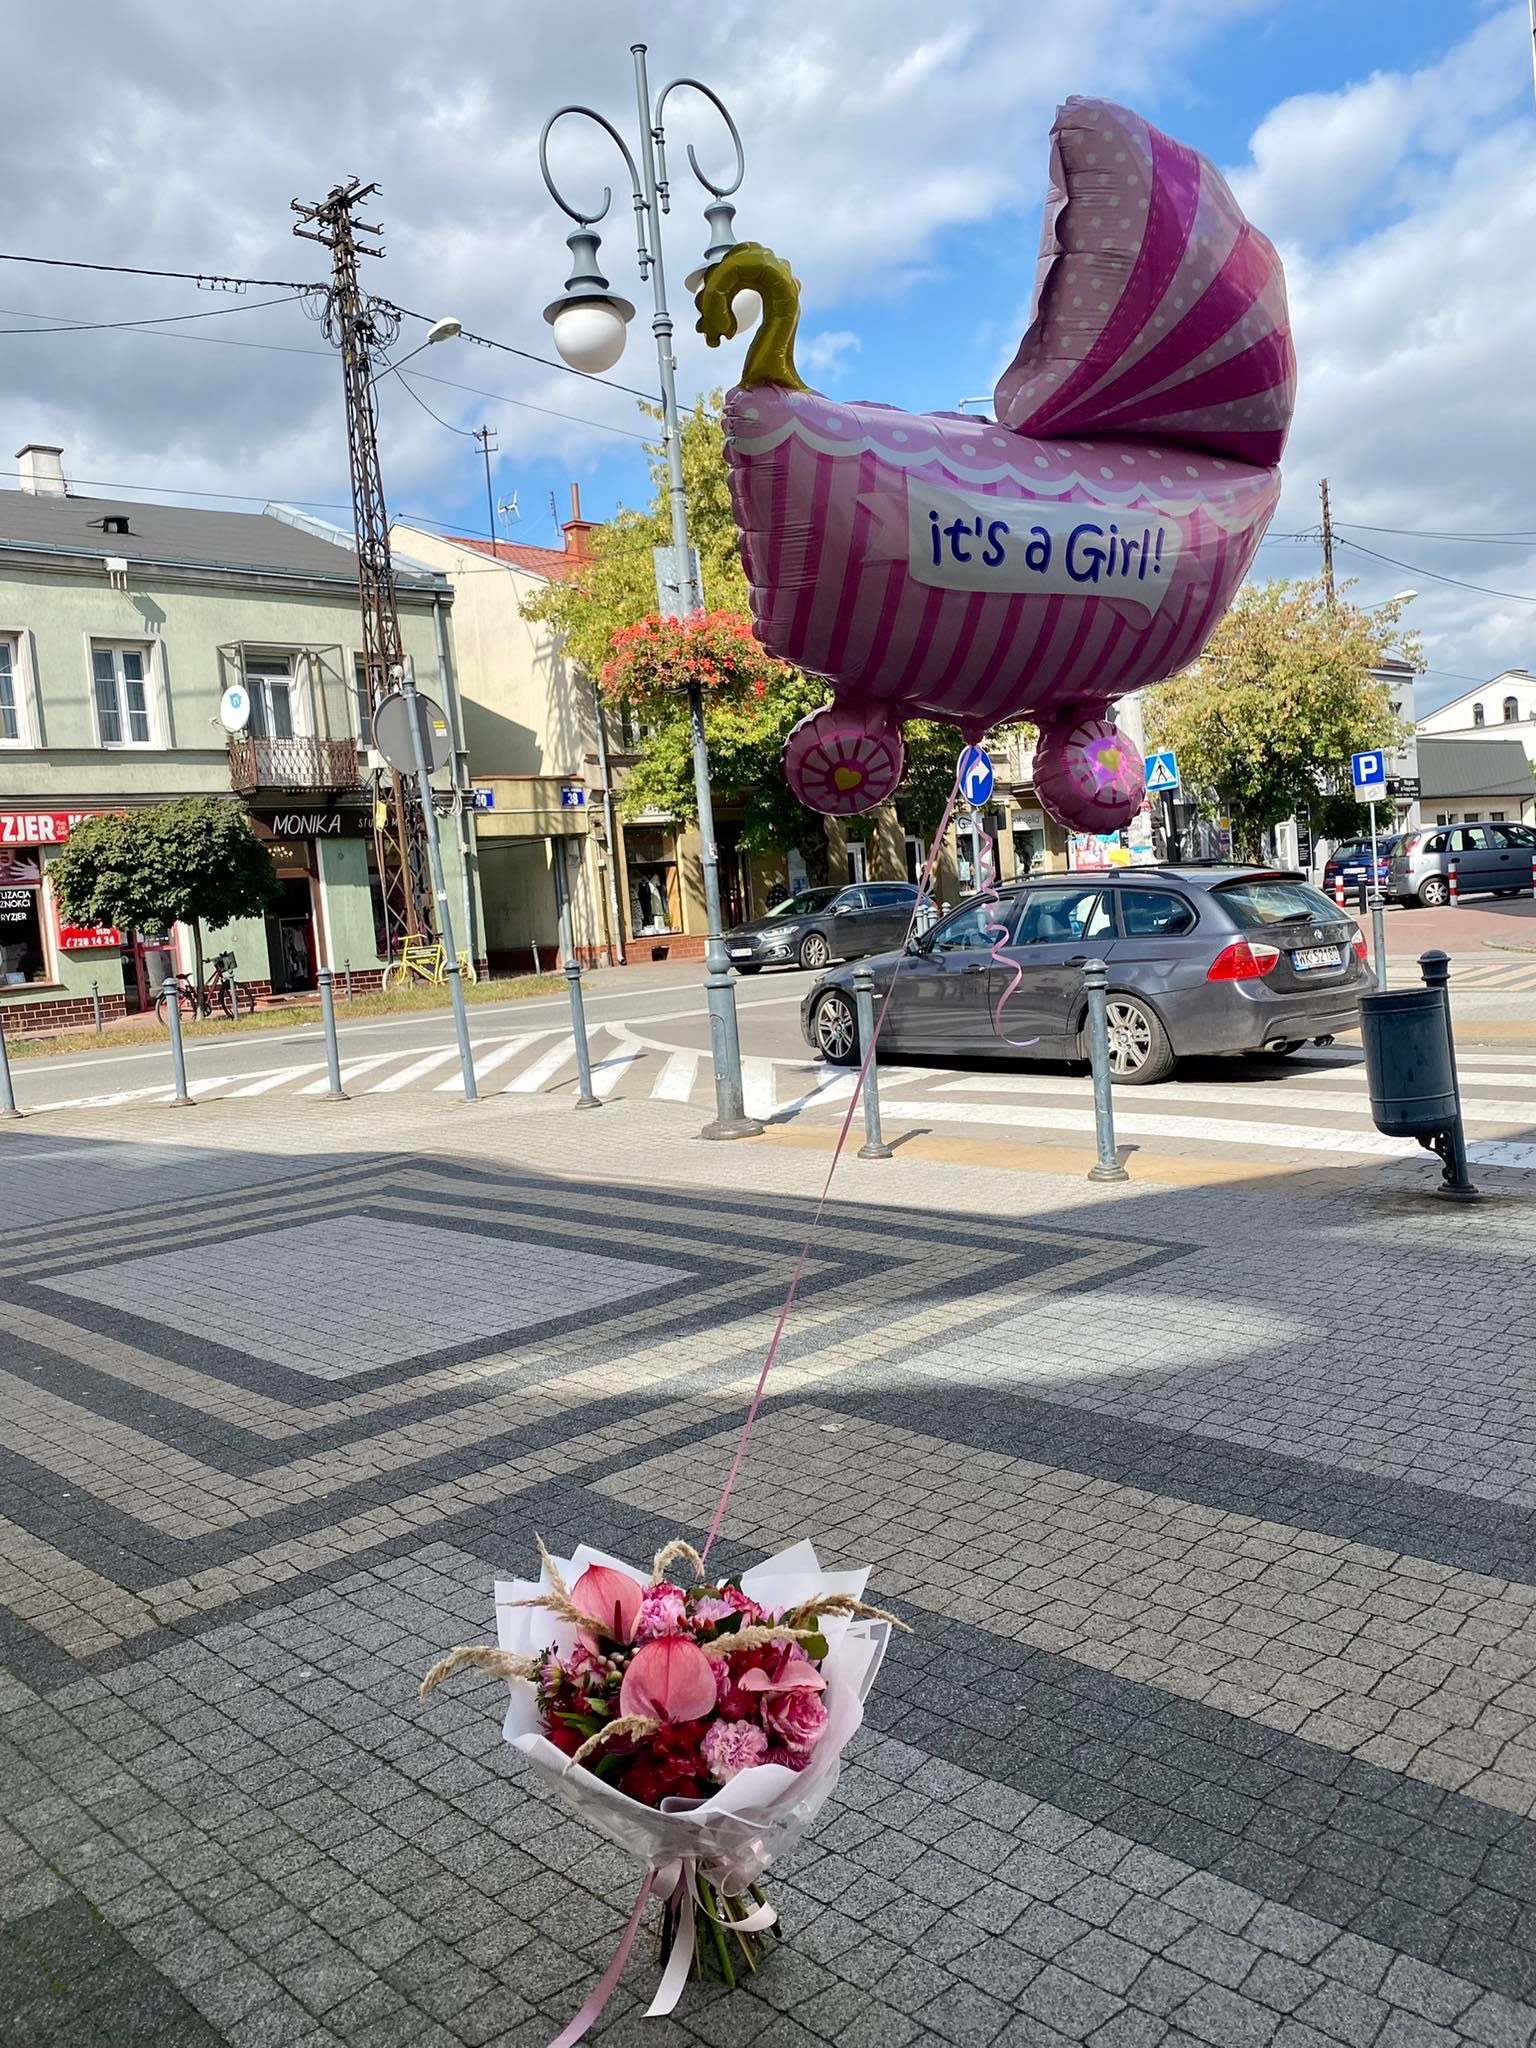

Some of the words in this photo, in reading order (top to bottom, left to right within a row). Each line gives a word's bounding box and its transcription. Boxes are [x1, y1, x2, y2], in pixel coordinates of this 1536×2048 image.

[928, 510, 1010, 567] it's
[1025, 526, 1053, 574] a
[1065, 523, 1165, 583] Girl!
[1359, 755, 1378, 783] P
[0, 815, 56, 841] ZJER
[273, 814, 342, 835] MONIKA
[358, 818, 389, 829] STUO
[0, 890, 31, 900] LIZACJA
